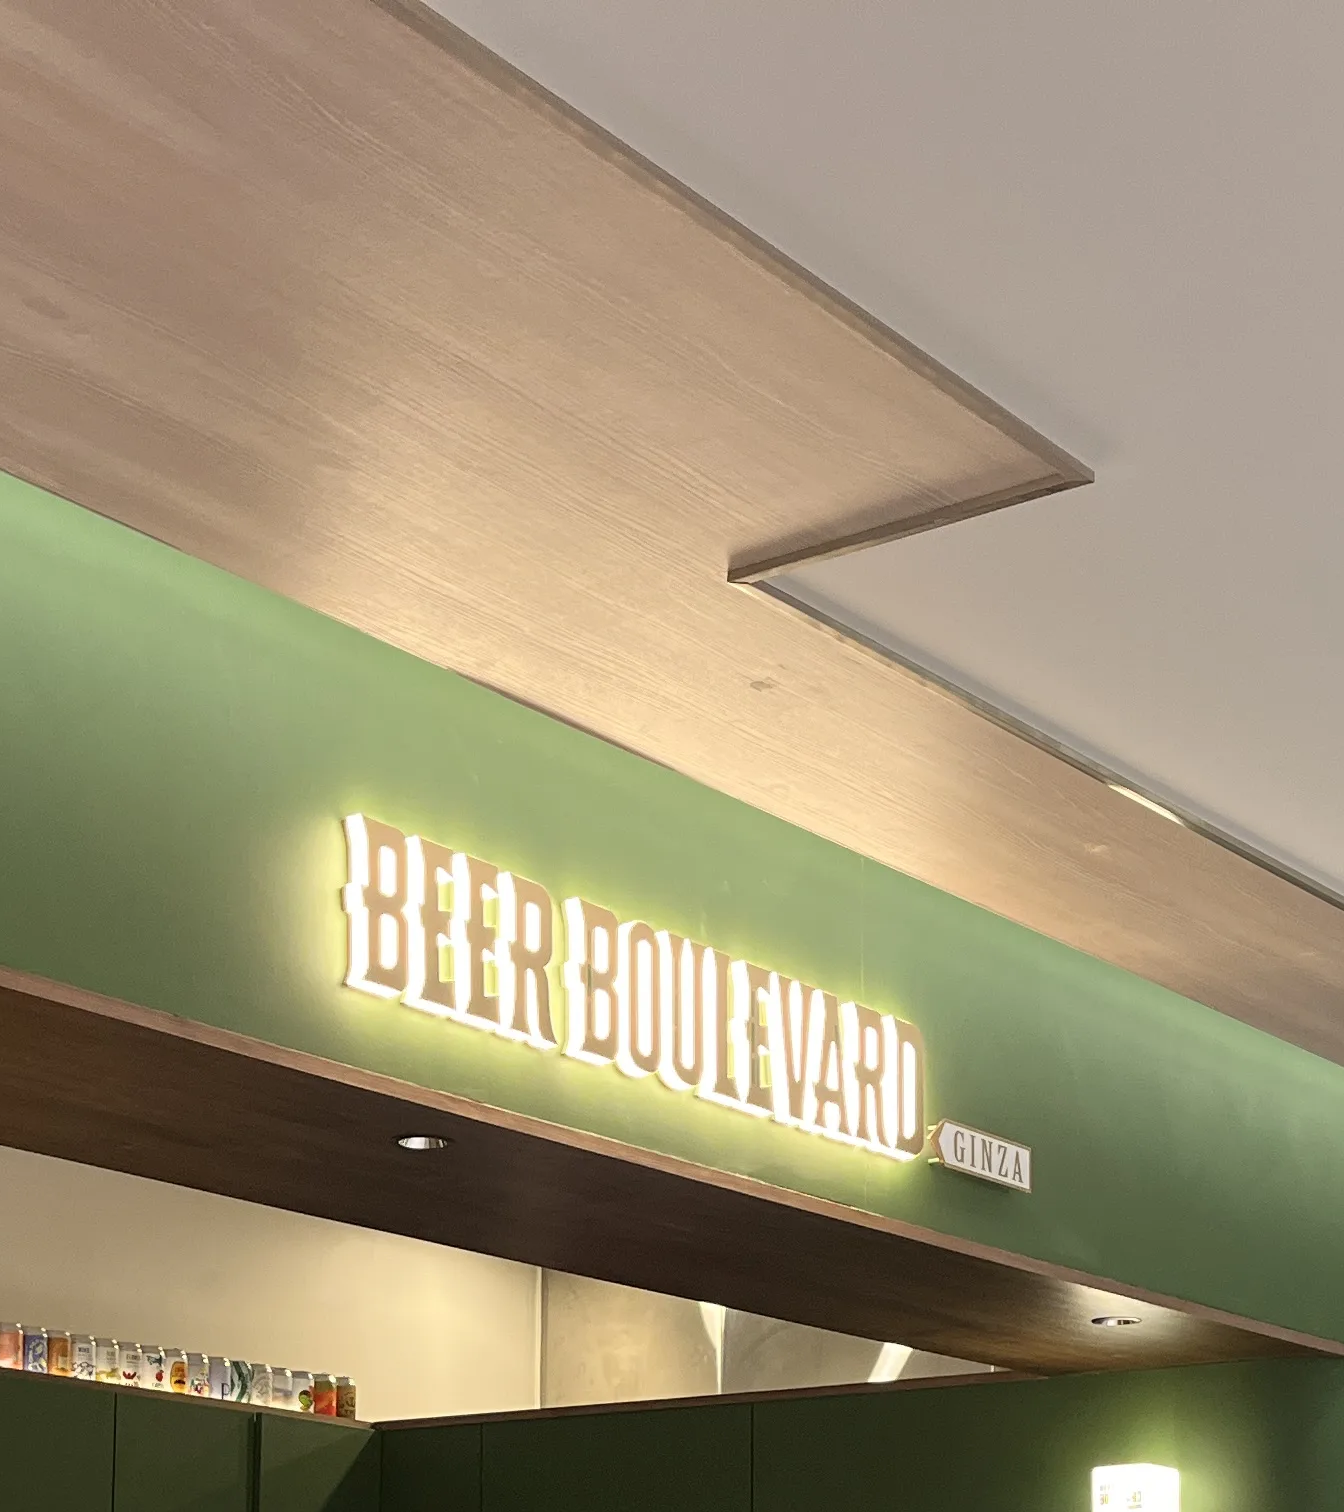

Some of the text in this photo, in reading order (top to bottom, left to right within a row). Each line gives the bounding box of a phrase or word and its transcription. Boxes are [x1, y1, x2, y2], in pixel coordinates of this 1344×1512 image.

[343, 813, 924, 1161] BEER BOULEVARD
[953, 1130, 1024, 1184] GINZA
